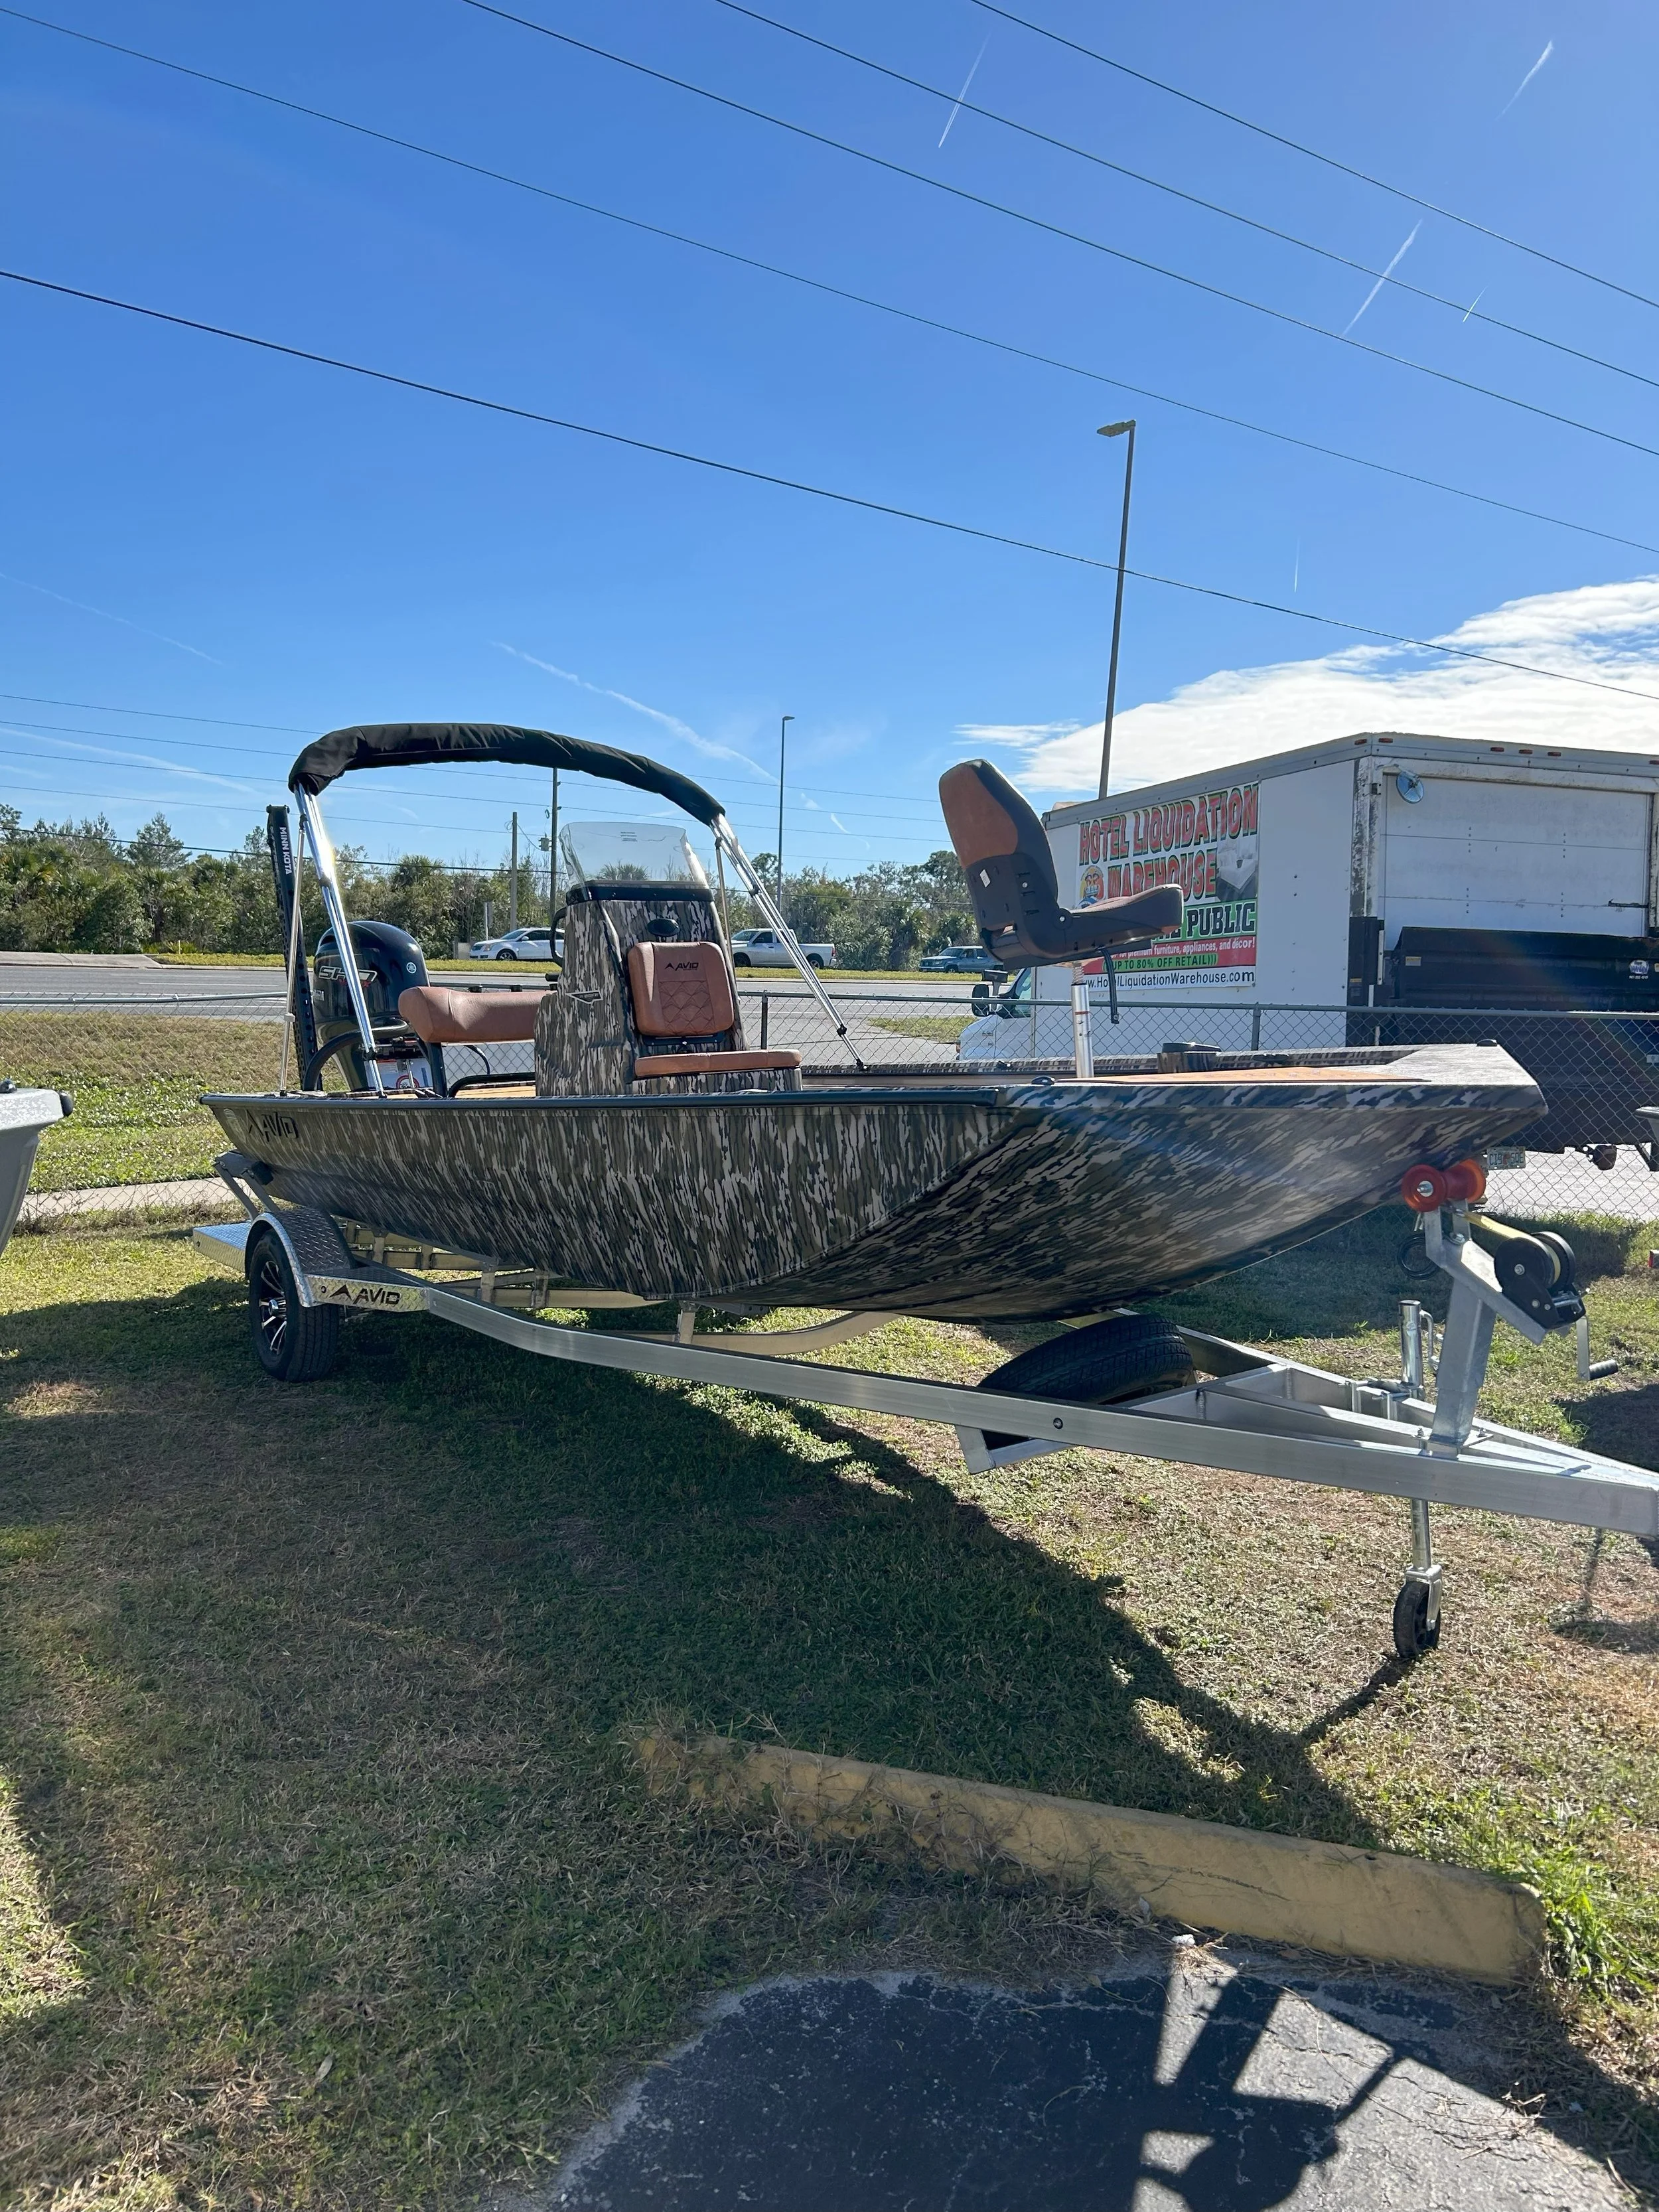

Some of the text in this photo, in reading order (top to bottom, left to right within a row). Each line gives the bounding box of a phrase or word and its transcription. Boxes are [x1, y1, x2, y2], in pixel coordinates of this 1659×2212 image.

[1079, 783, 1259, 866] HOTEL LIQUIDATION
[279, 826, 293, 875] MINN KOTA
[1108, 848, 1217, 902] WAREHOUSE
[1187, 901, 1256, 938] PUBLIC
[1153, 943, 1182, 955] furniture,
[1183, 941, 1218, 955] appliances,
[1219, 938, 1231, 950] and
[1232, 936, 1256, 948] décor!
[675, 961, 699, 971] AVID
[1125, 960, 1134, 969] TO
[1137, 958, 1154, 968] 80%
[1157, 956, 1173, 968] OFF
[353, 1288, 401, 1305] AVID
